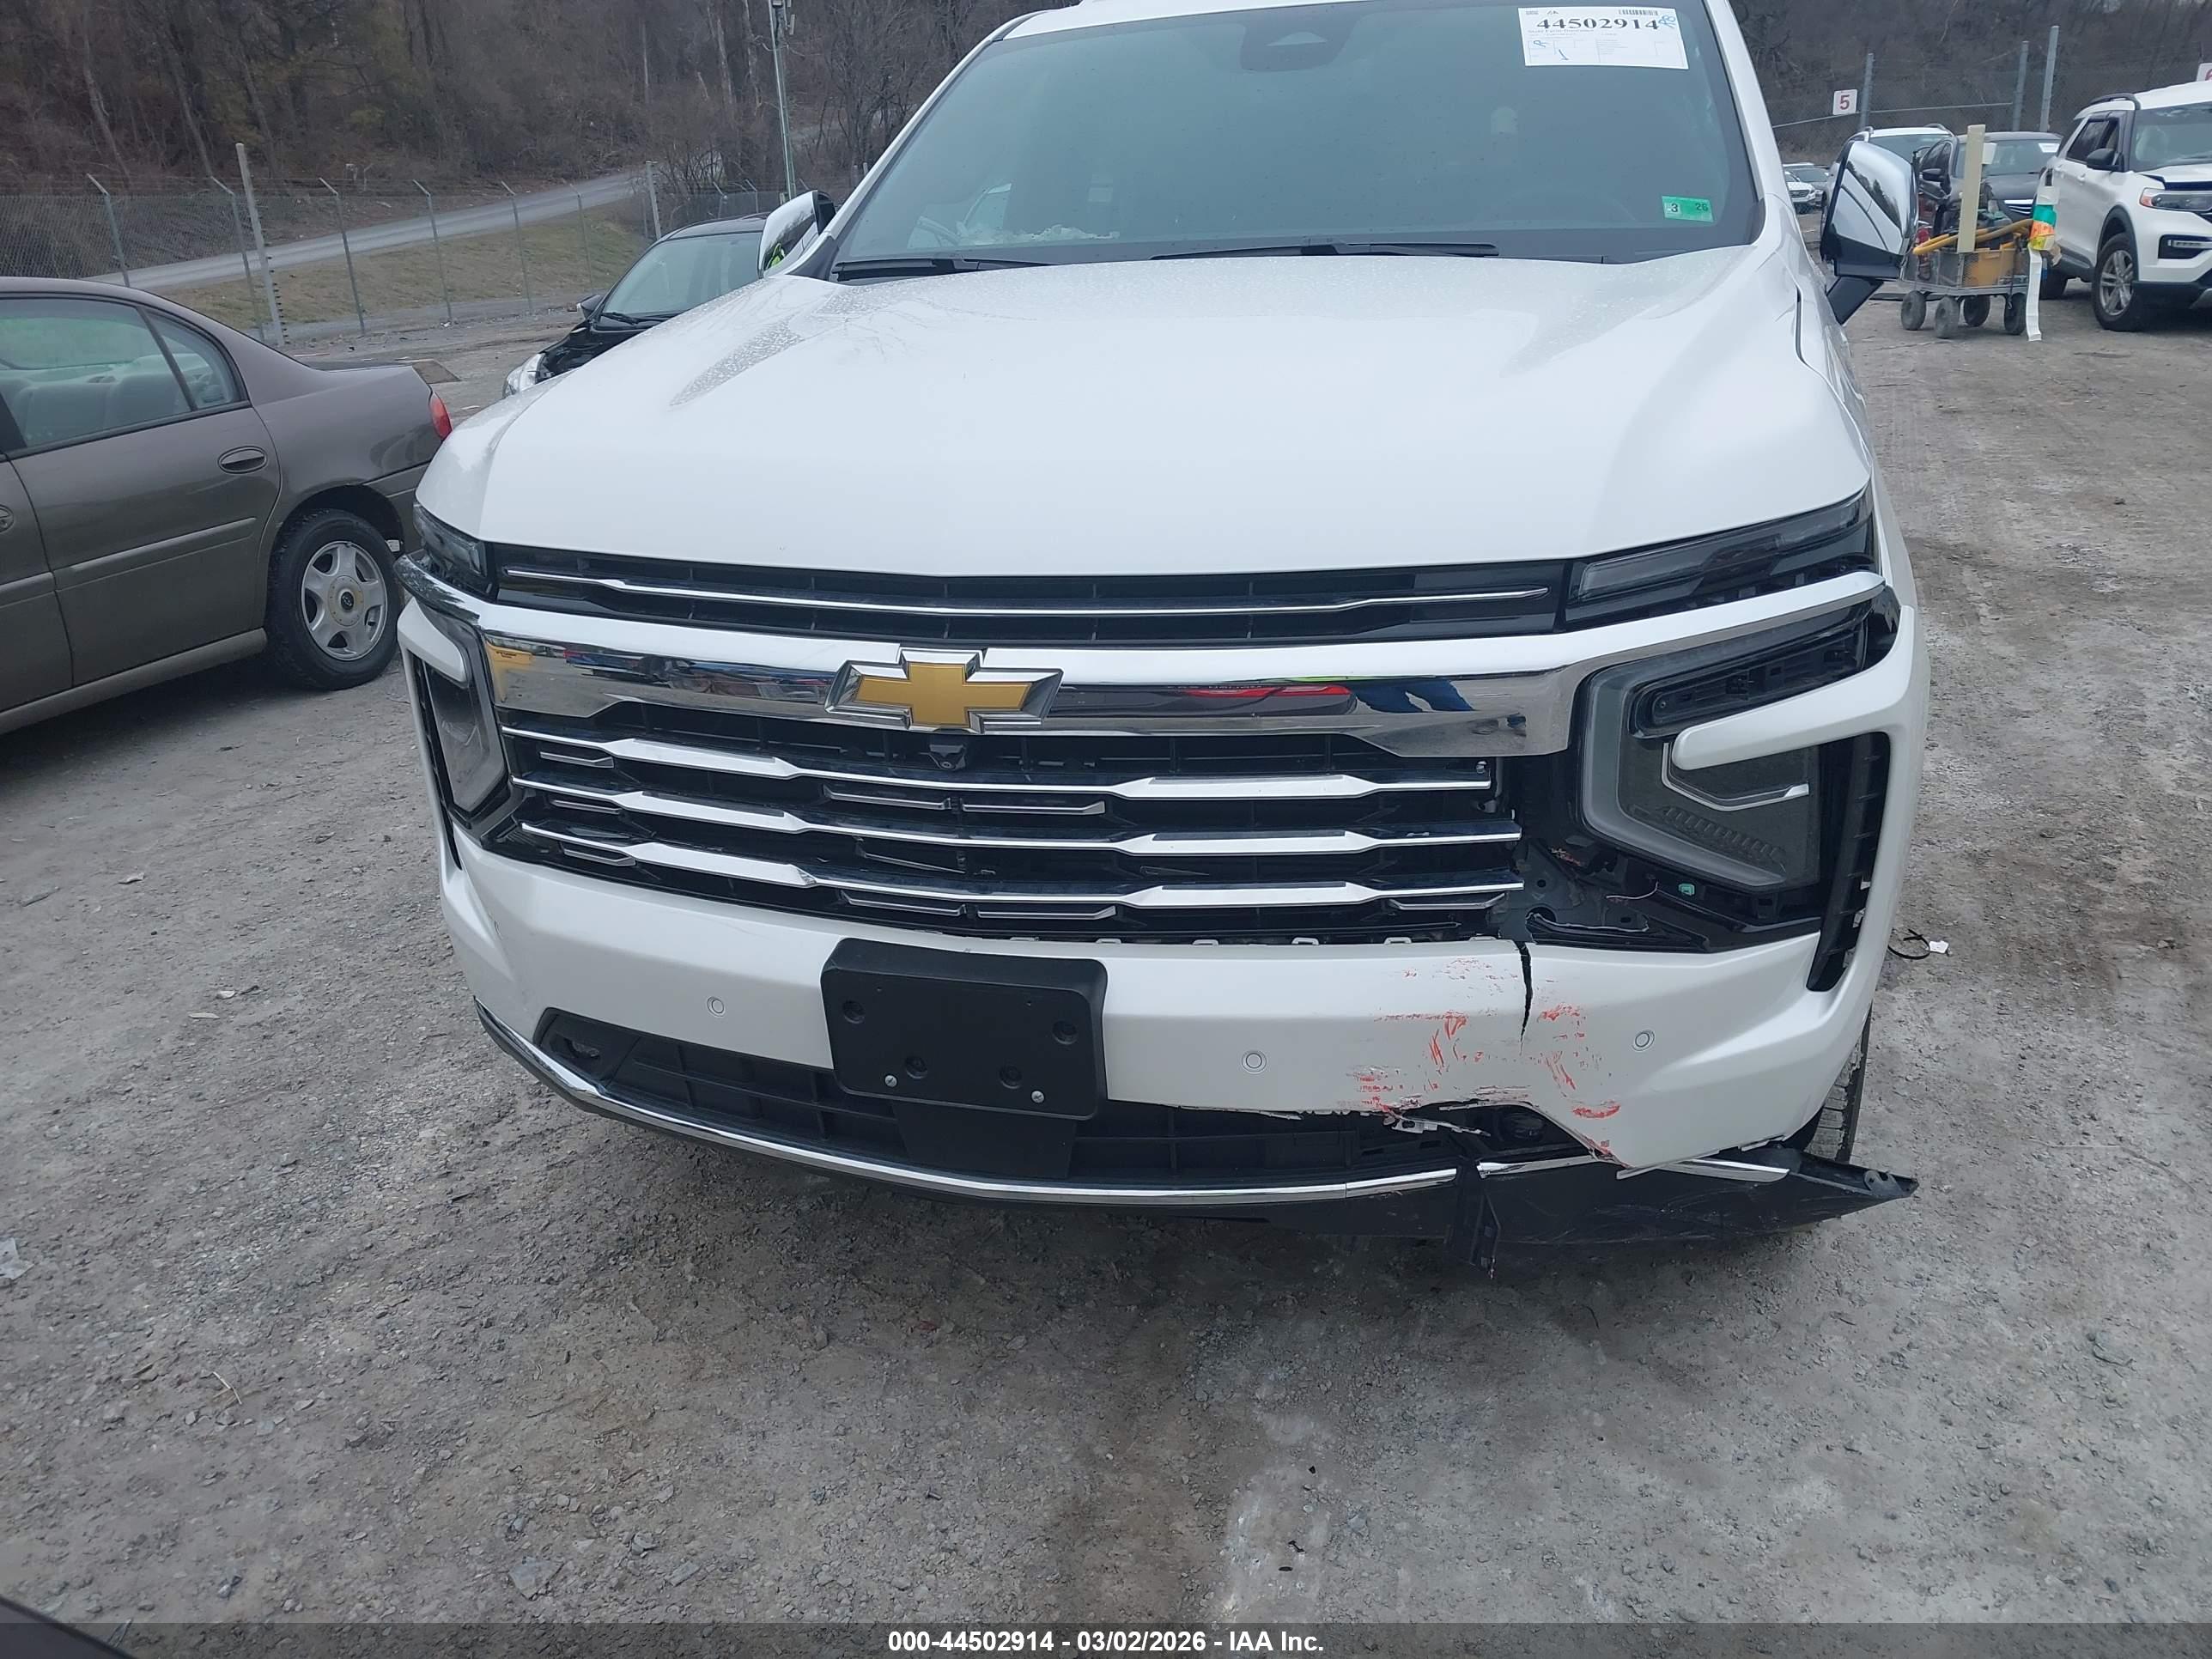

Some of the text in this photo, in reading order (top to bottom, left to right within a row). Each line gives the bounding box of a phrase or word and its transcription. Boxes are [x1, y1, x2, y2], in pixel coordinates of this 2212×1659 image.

[1537, 18, 1659, 29] 44502914
[1840, 94, 1850, 110] 5
[1671, 203, 1679, 213] 3
